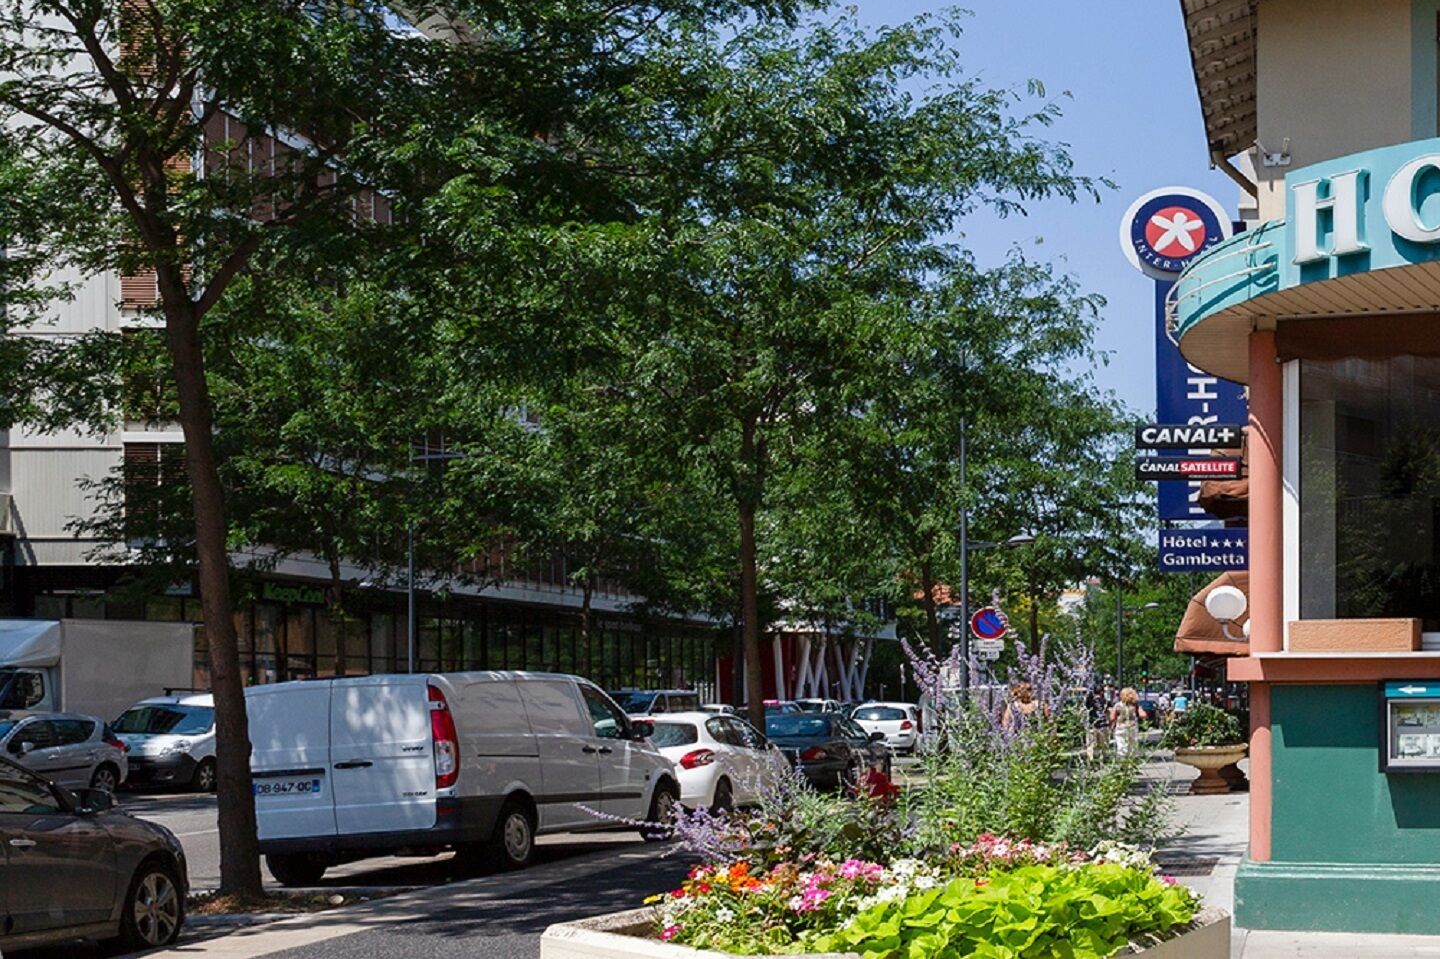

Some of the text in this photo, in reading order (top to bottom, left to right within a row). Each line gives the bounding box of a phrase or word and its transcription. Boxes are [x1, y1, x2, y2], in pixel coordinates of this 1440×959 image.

[1141, 427, 1235, 444] CANAL+
[1163, 535, 1207, 548] Hôtel
[1163, 552, 1245, 566] Gambetta
